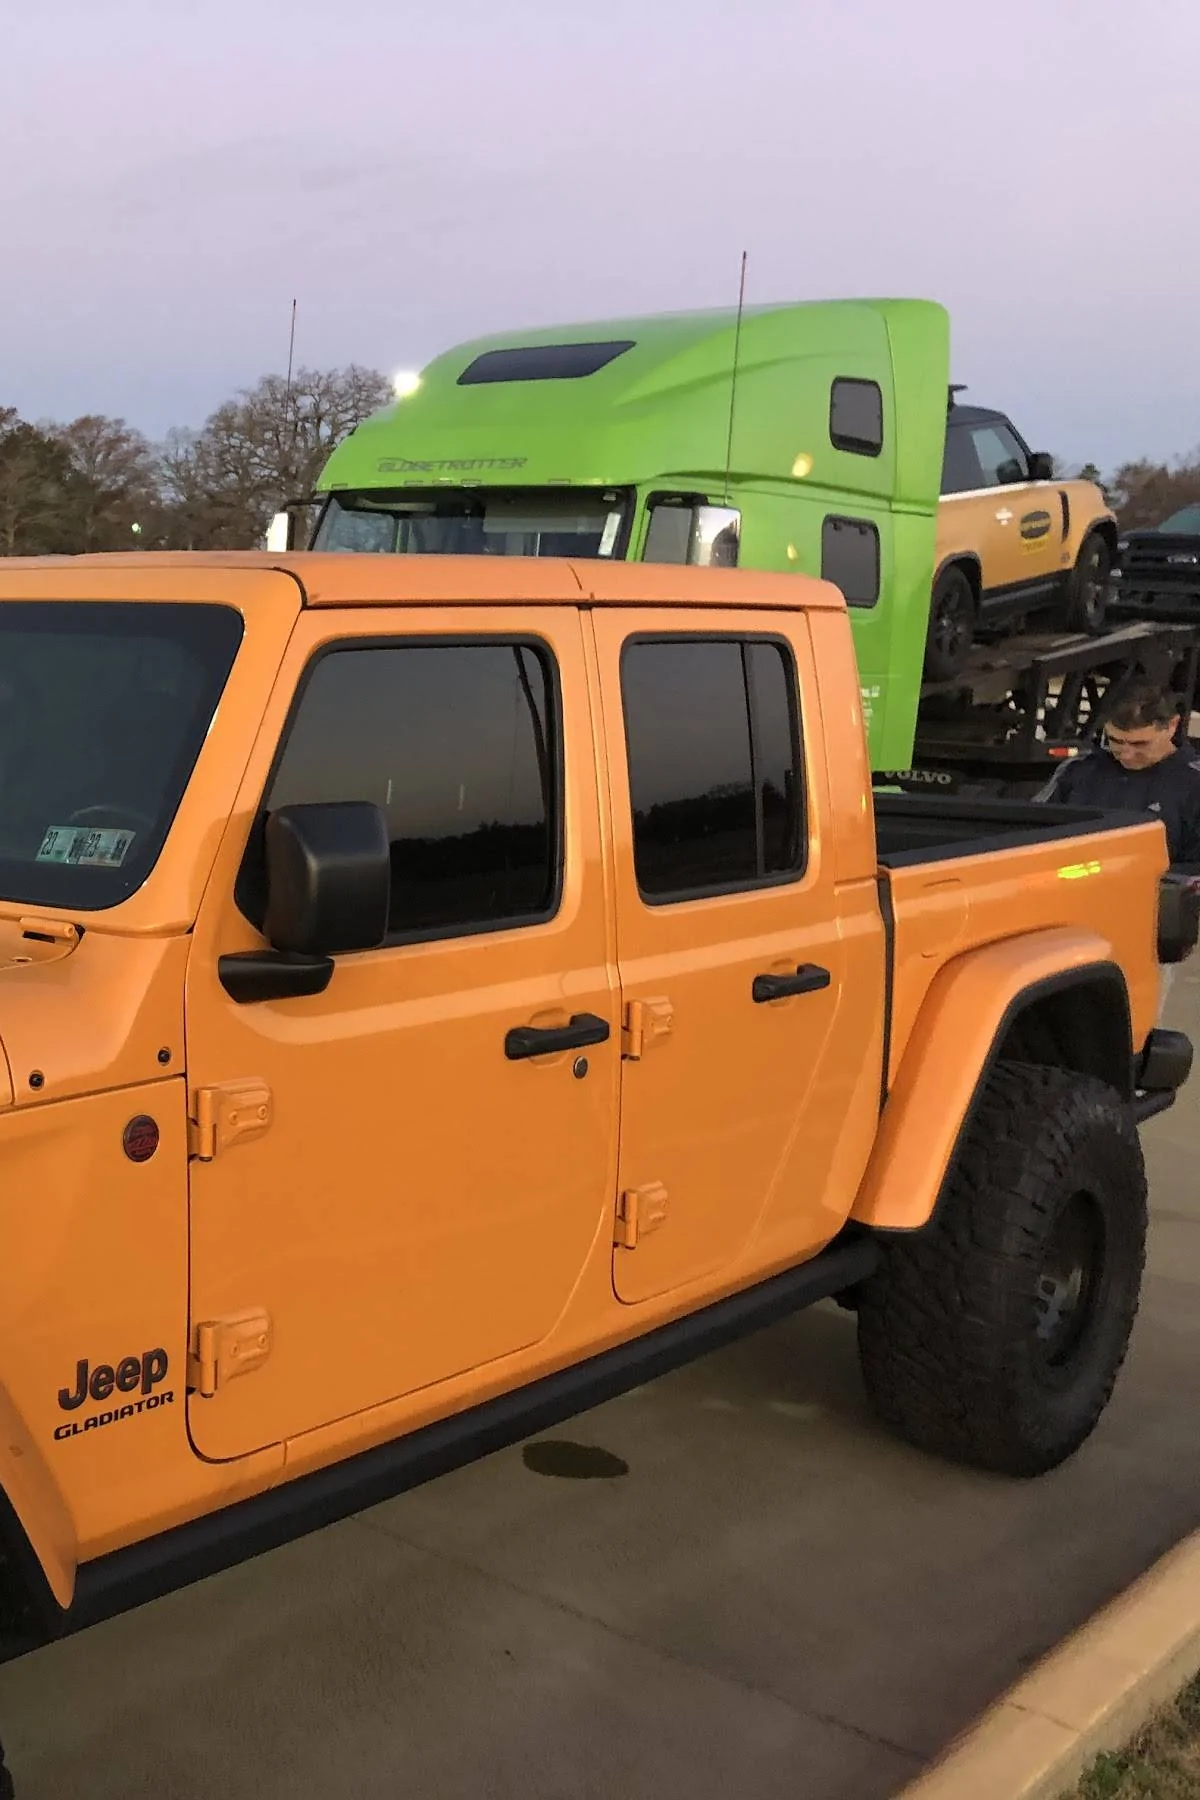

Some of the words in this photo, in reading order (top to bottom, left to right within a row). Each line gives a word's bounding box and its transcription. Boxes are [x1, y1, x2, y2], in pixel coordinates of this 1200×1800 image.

[884, 768, 952, 785] VOLVO
[57, 1347, 169, 1411] Jeep
[53, 1391, 175, 1441] GLADIATOR
